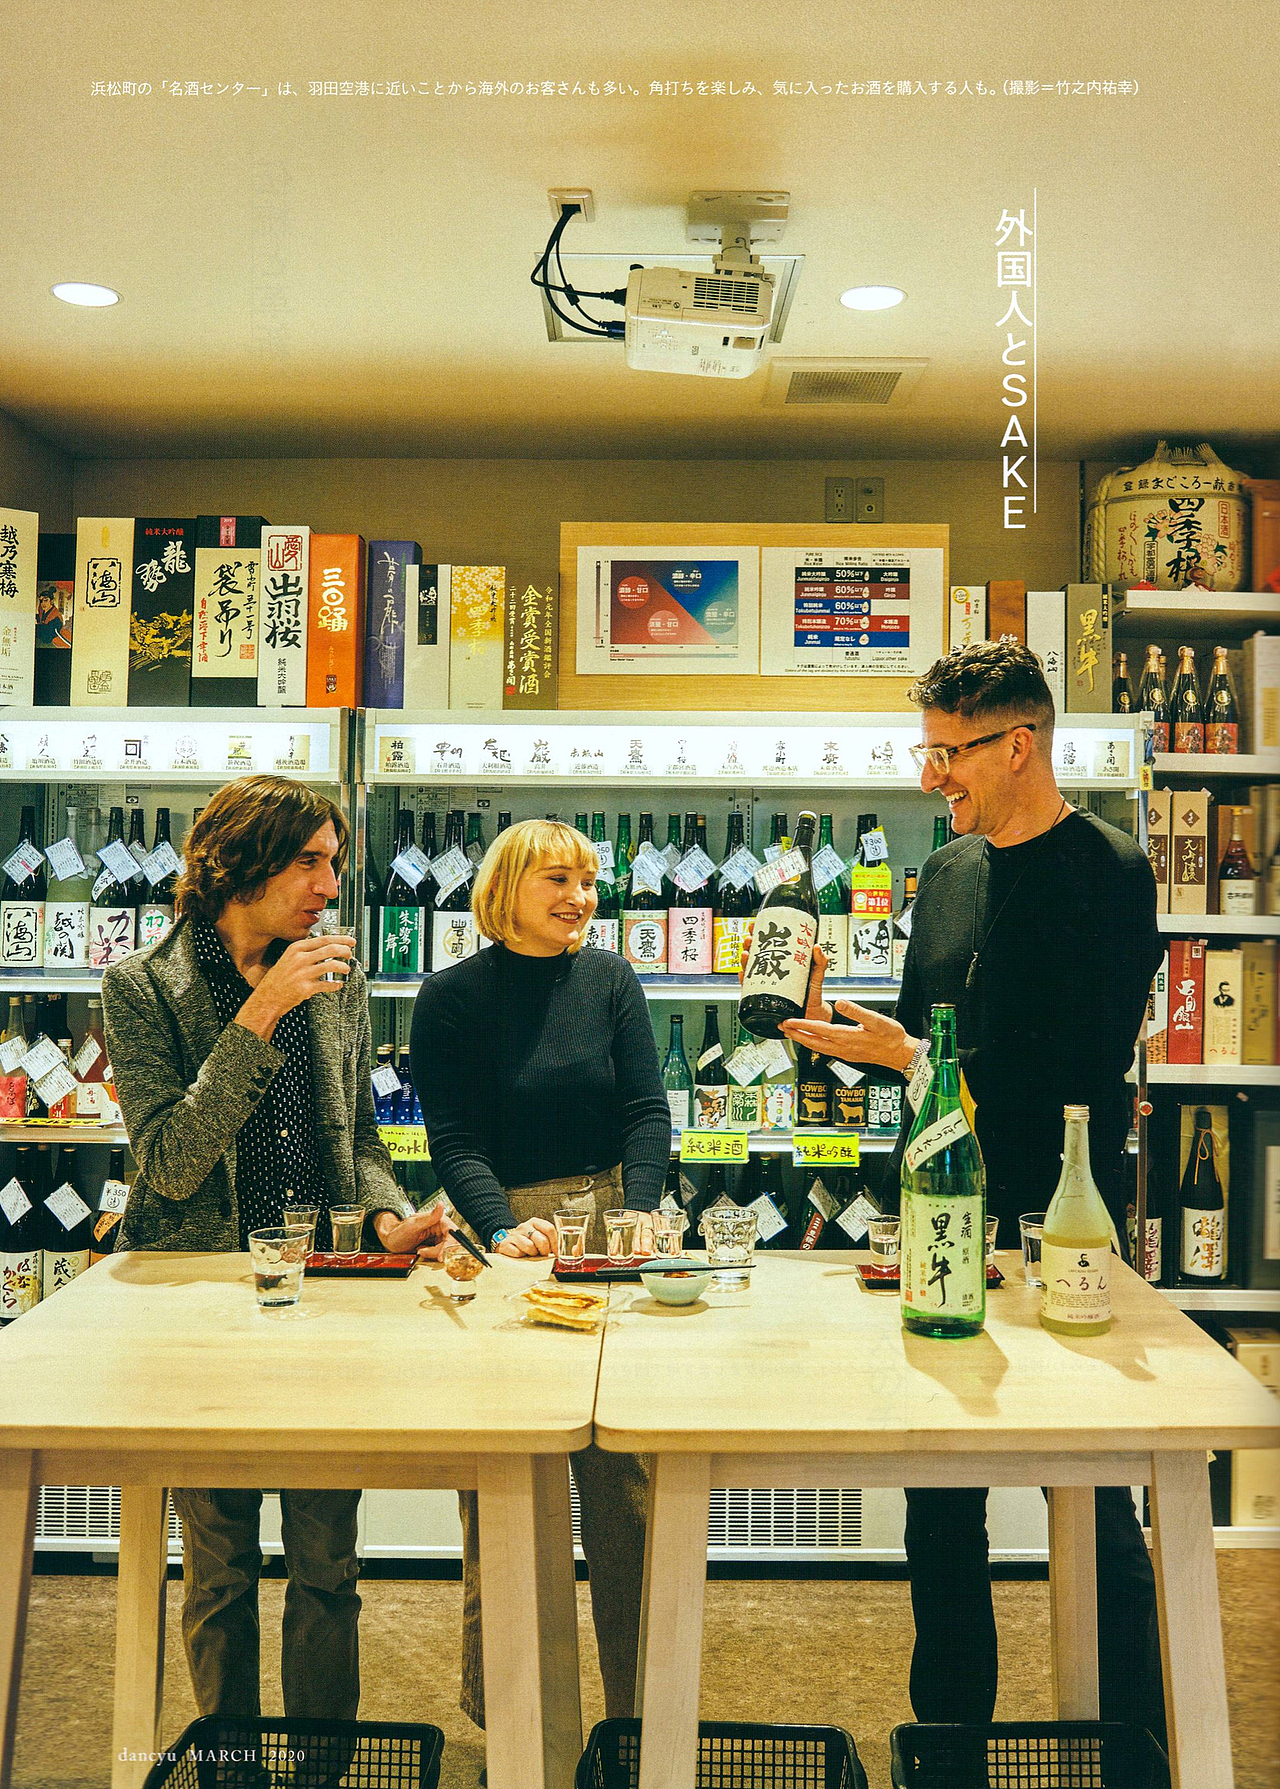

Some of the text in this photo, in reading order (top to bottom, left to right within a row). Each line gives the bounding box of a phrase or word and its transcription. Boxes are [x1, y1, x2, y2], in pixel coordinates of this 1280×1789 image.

[1219, 503, 1229, 535] 日本酒
[264, 573, 303, 649] 出羽桜
[519, 585, 543, 695] 金賞受賞酒
[1076, 609, 1102, 695] 黒牛
[681, 915, 699, 962] 四季桜
[687, 1139, 743, 1156] 純米酒
[913, 1118, 963, 1160] しぼりたて
[928, 1212, 955, 1308] 黒牛
